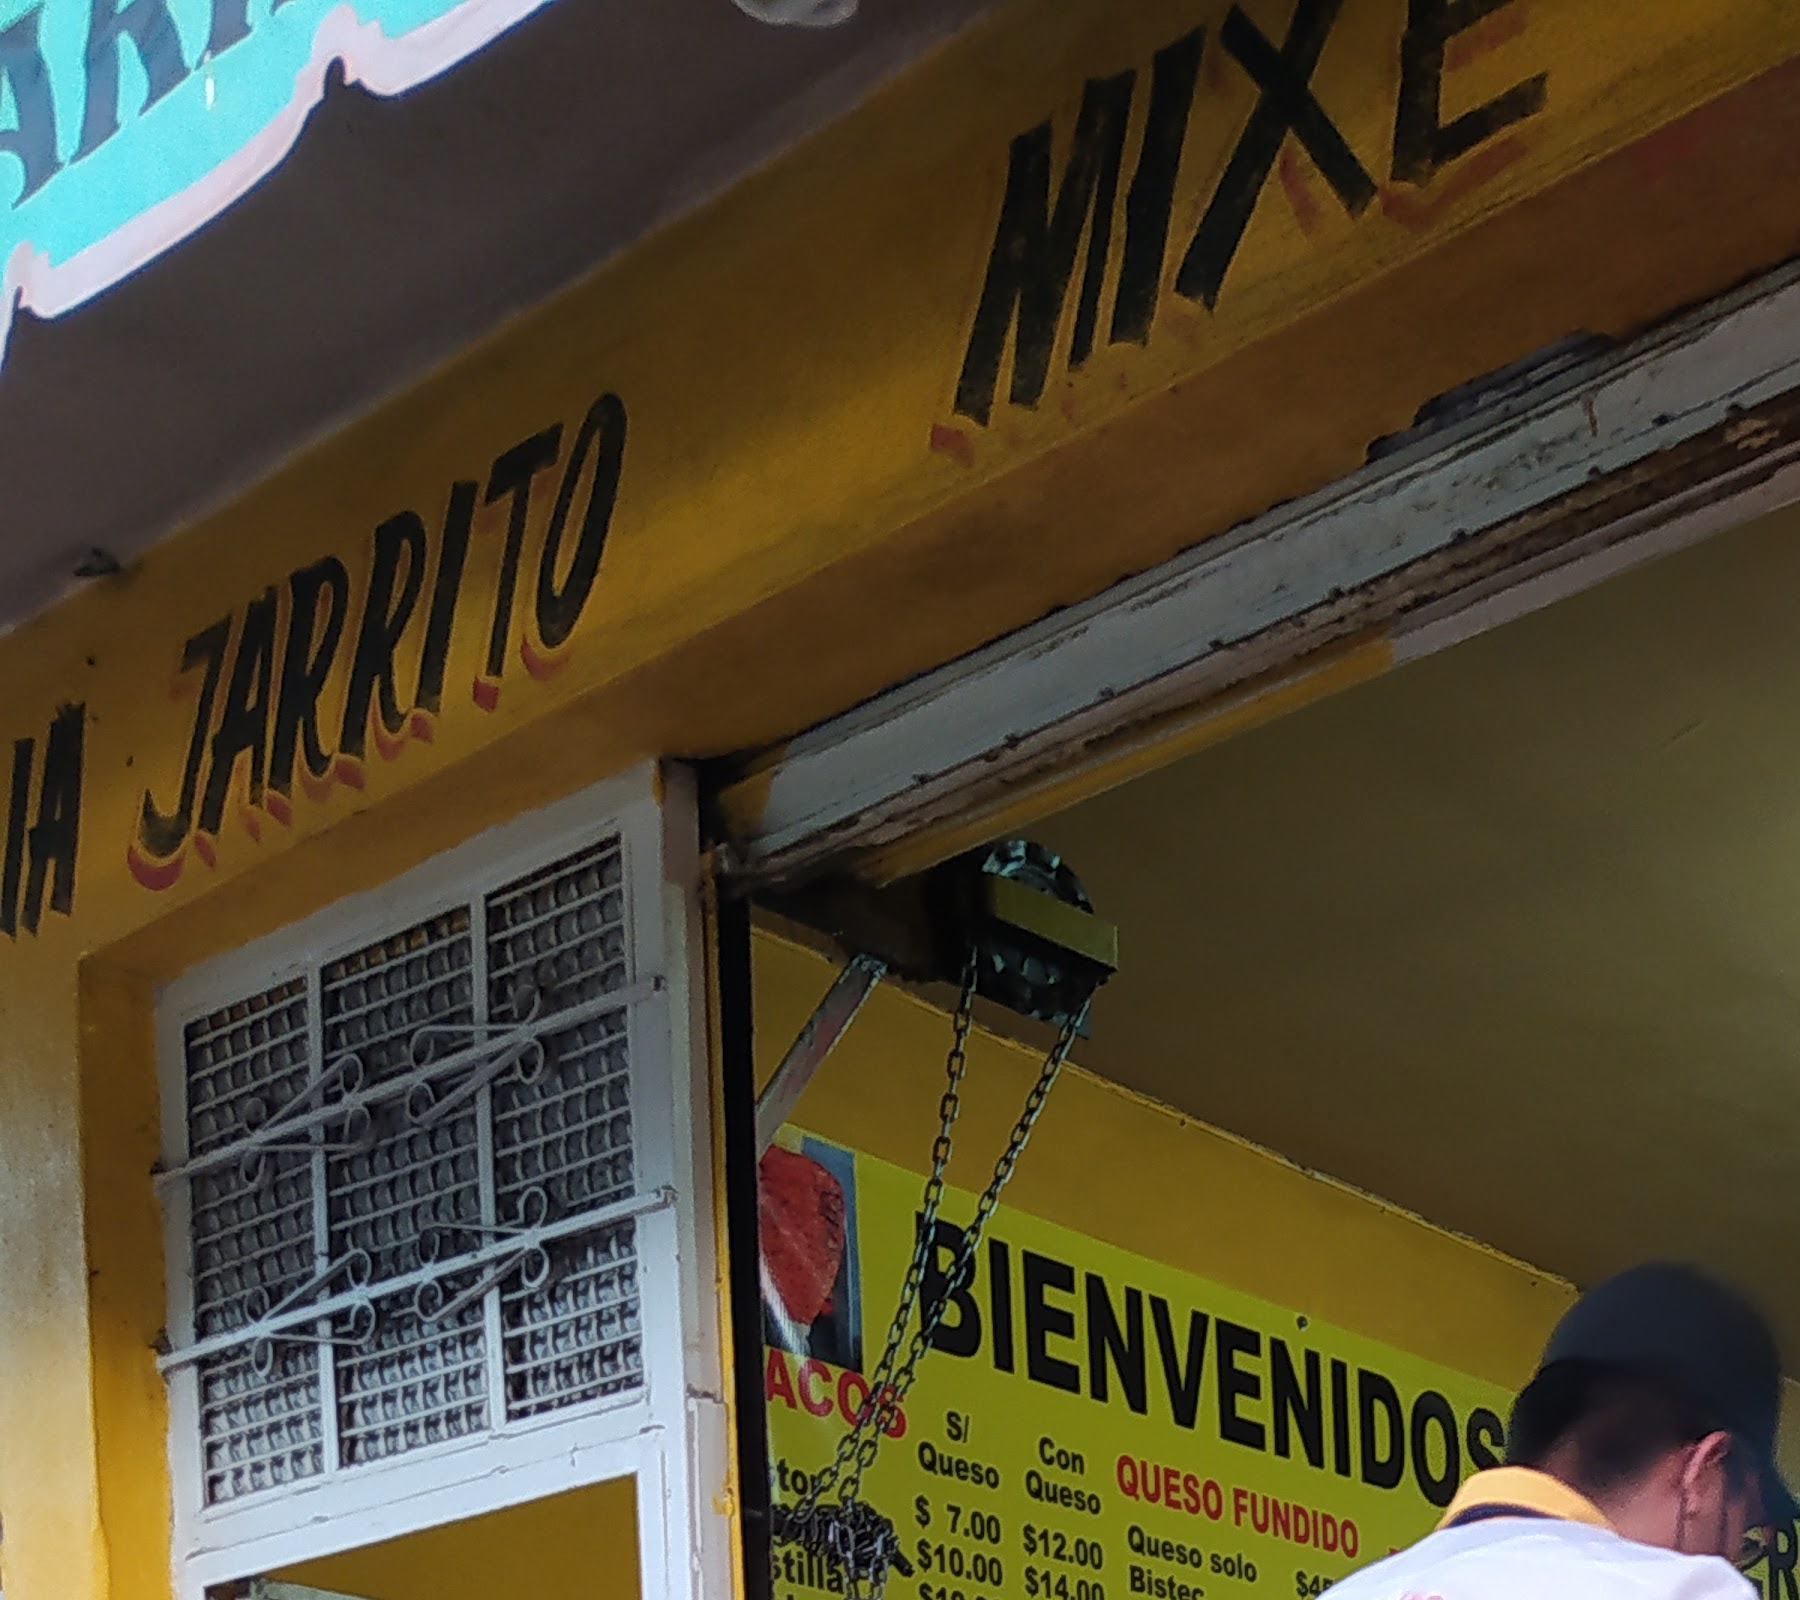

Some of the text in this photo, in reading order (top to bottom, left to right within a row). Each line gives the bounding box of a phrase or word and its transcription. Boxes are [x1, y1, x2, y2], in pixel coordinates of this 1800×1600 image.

[140, 392, 627, 858] JARRITO
[918, 1441, 999, 1489] Queso
[1038, 1437, 1084, 1475] Con
[1025, 1469, 1101, 1515] Queso
[1116, 1454, 1359, 1559] QUESO FUNDIDO
[917, 1539, 1003, 1587] $10.00
[1022, 1524, 1103, 1569] $12.00
[1128, 1525, 1258, 1583] Queso solo
